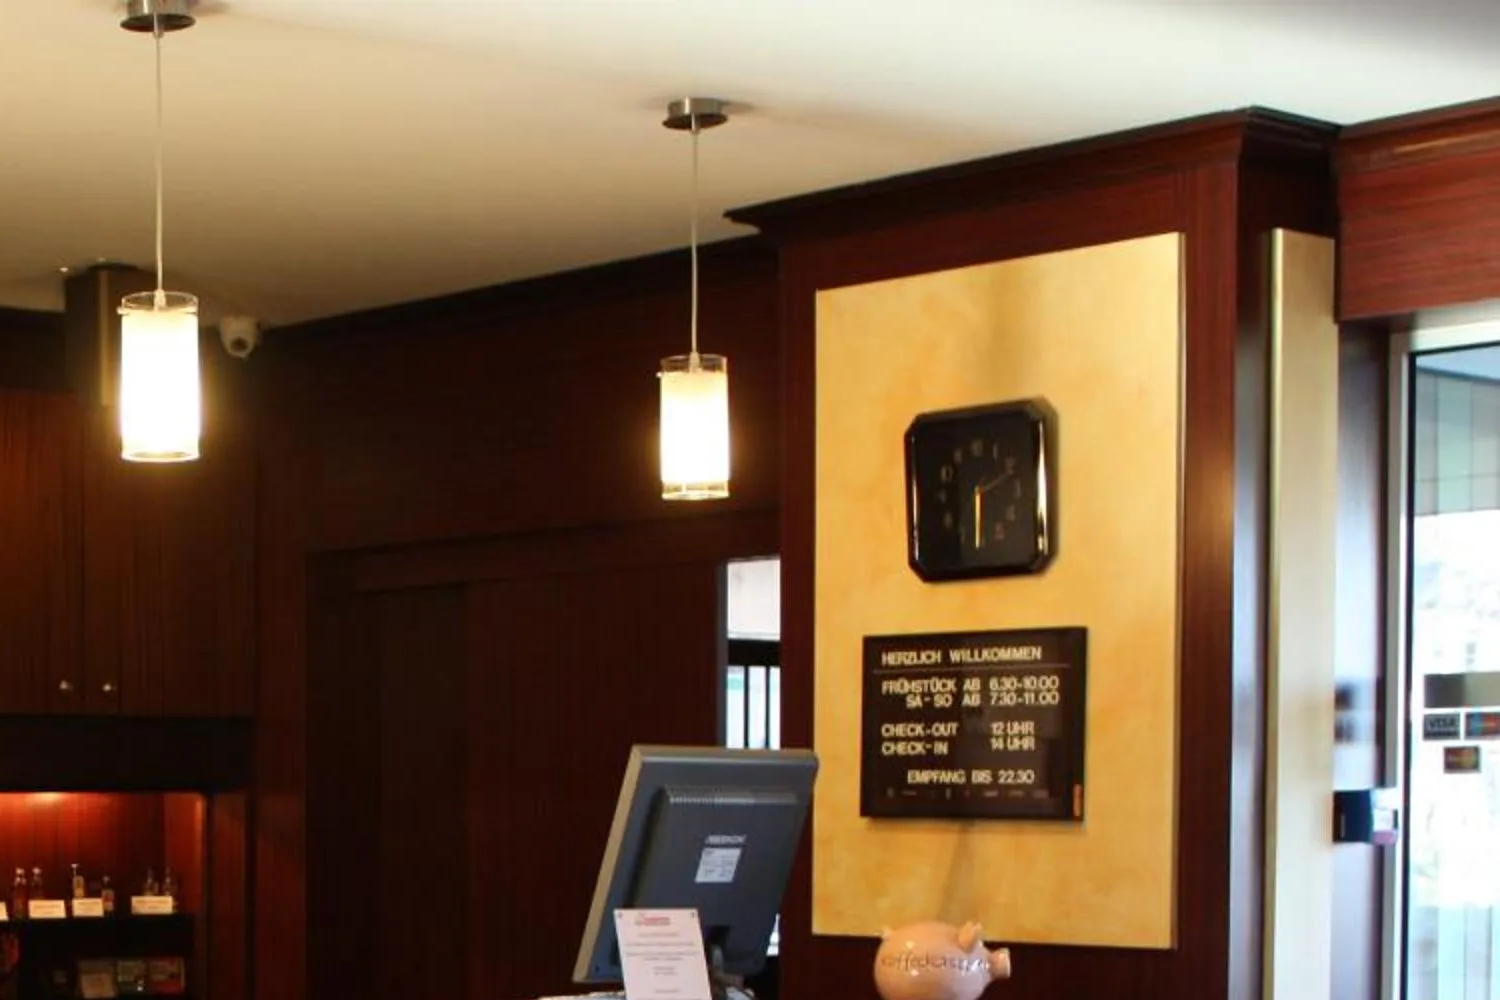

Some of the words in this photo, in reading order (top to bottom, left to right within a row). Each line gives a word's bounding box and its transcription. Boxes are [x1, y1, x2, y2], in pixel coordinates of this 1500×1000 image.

[882, 651, 941, 667] HERZLICH
[949, 646, 1042, 663] WILLKOMMEN
[882, 677, 957, 695] FRÜHSTÜCK
[963, 677, 980, 691] AB
[962, 693, 980, 707] AB
[990, 721, 1004, 735] 12
[1007, 720, 1035, 736] UHR
[1007, 736, 1036, 751] UHR
[907, 769, 966, 784] EMPFANG
[972, 769, 992, 784] BIS
